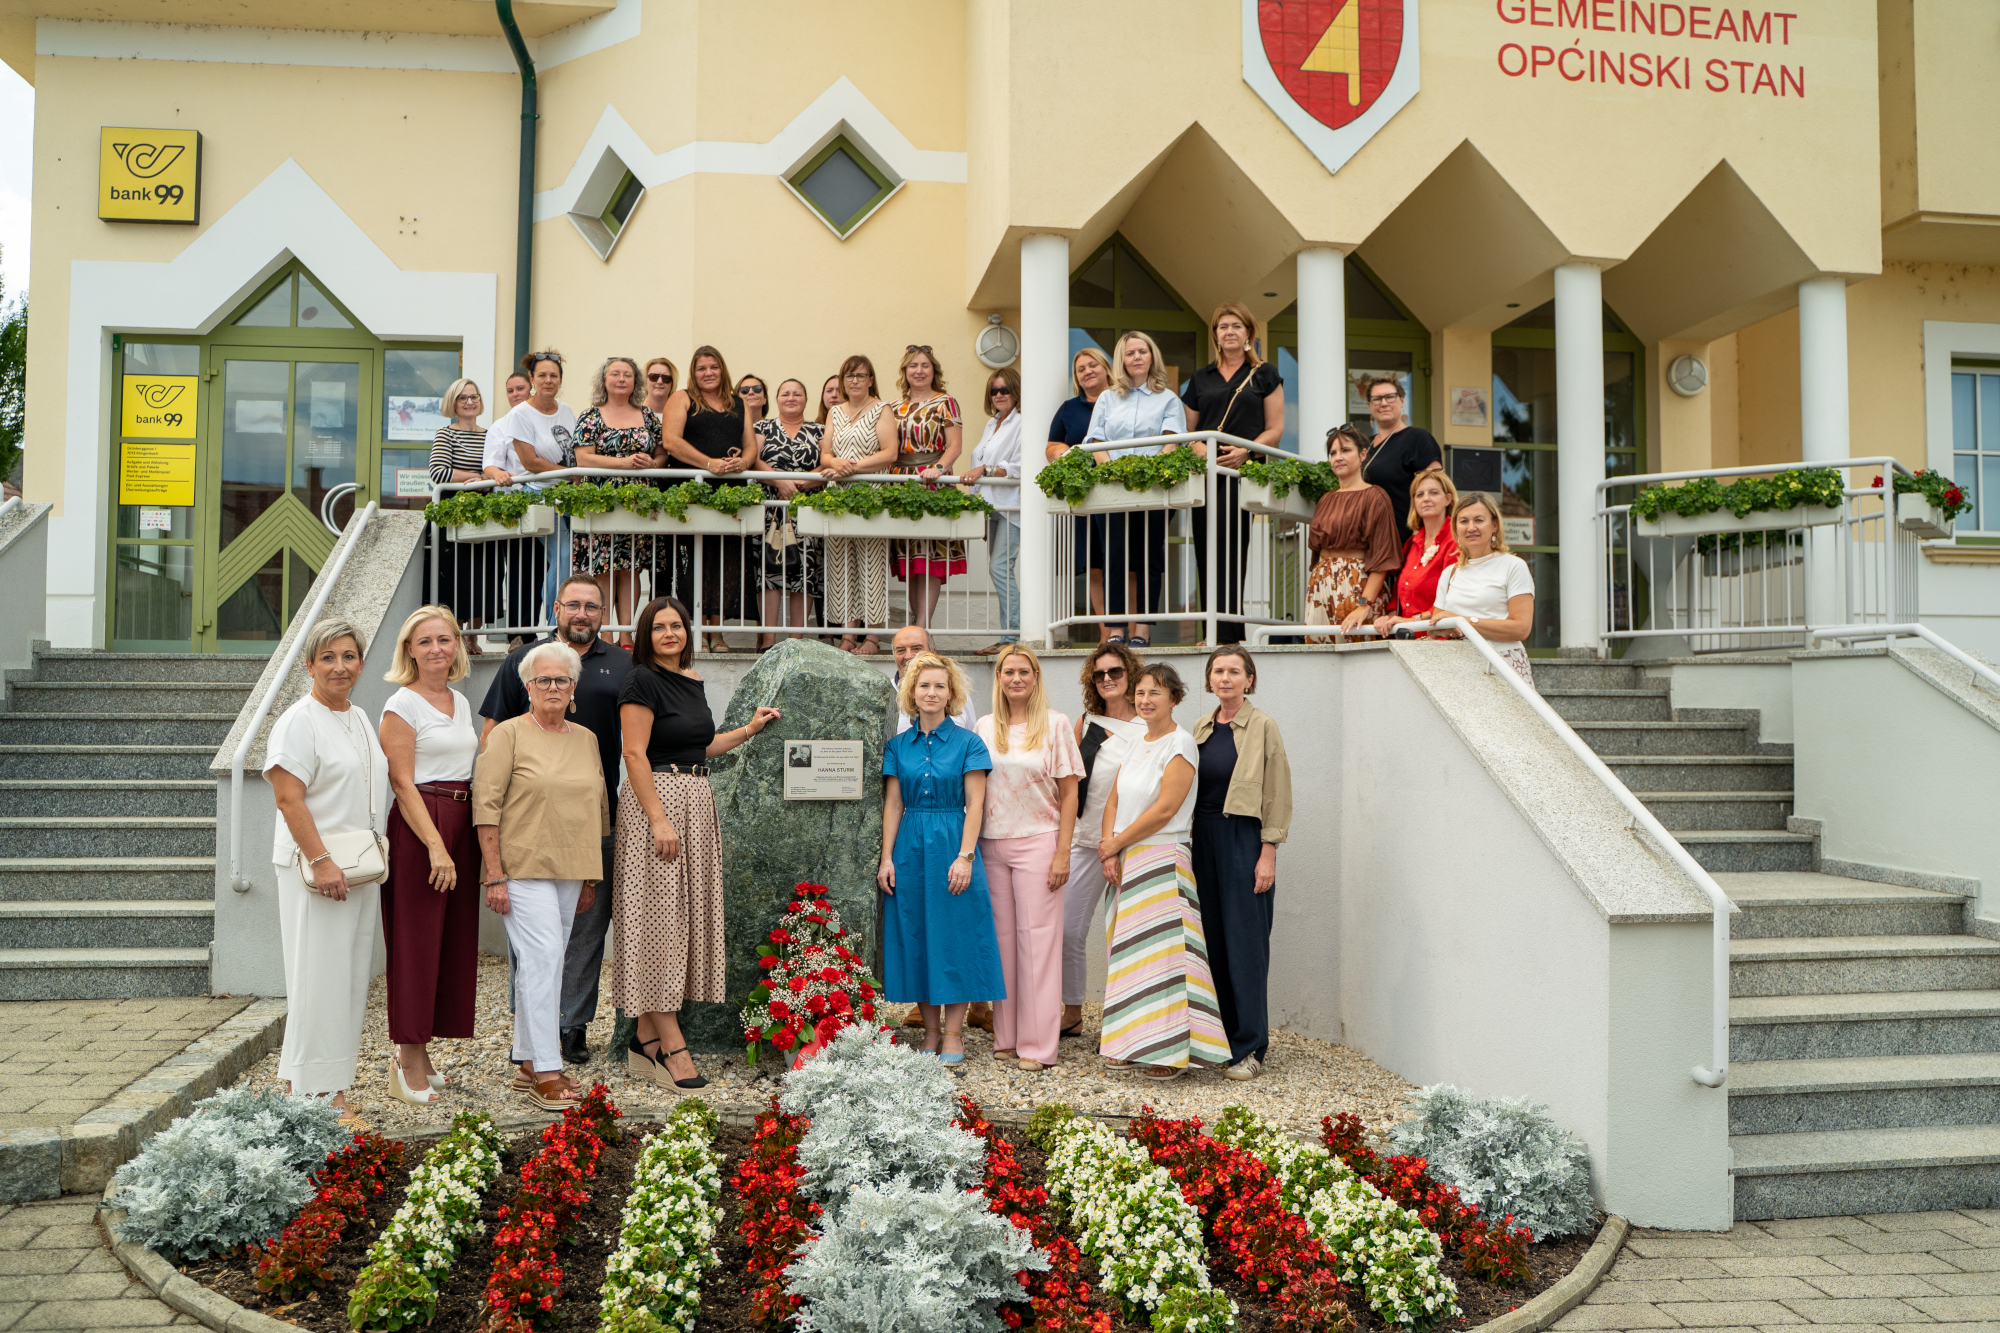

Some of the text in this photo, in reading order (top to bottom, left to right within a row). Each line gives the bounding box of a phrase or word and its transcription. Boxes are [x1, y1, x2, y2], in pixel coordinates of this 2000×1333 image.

[1497, 0, 1797, 45] GEMEINDEAMT
[1498, 38, 1804, 98] OPĆINSKI STAN
[110, 184, 184, 205] bank 99
[136, 413, 182, 426] bank 99
